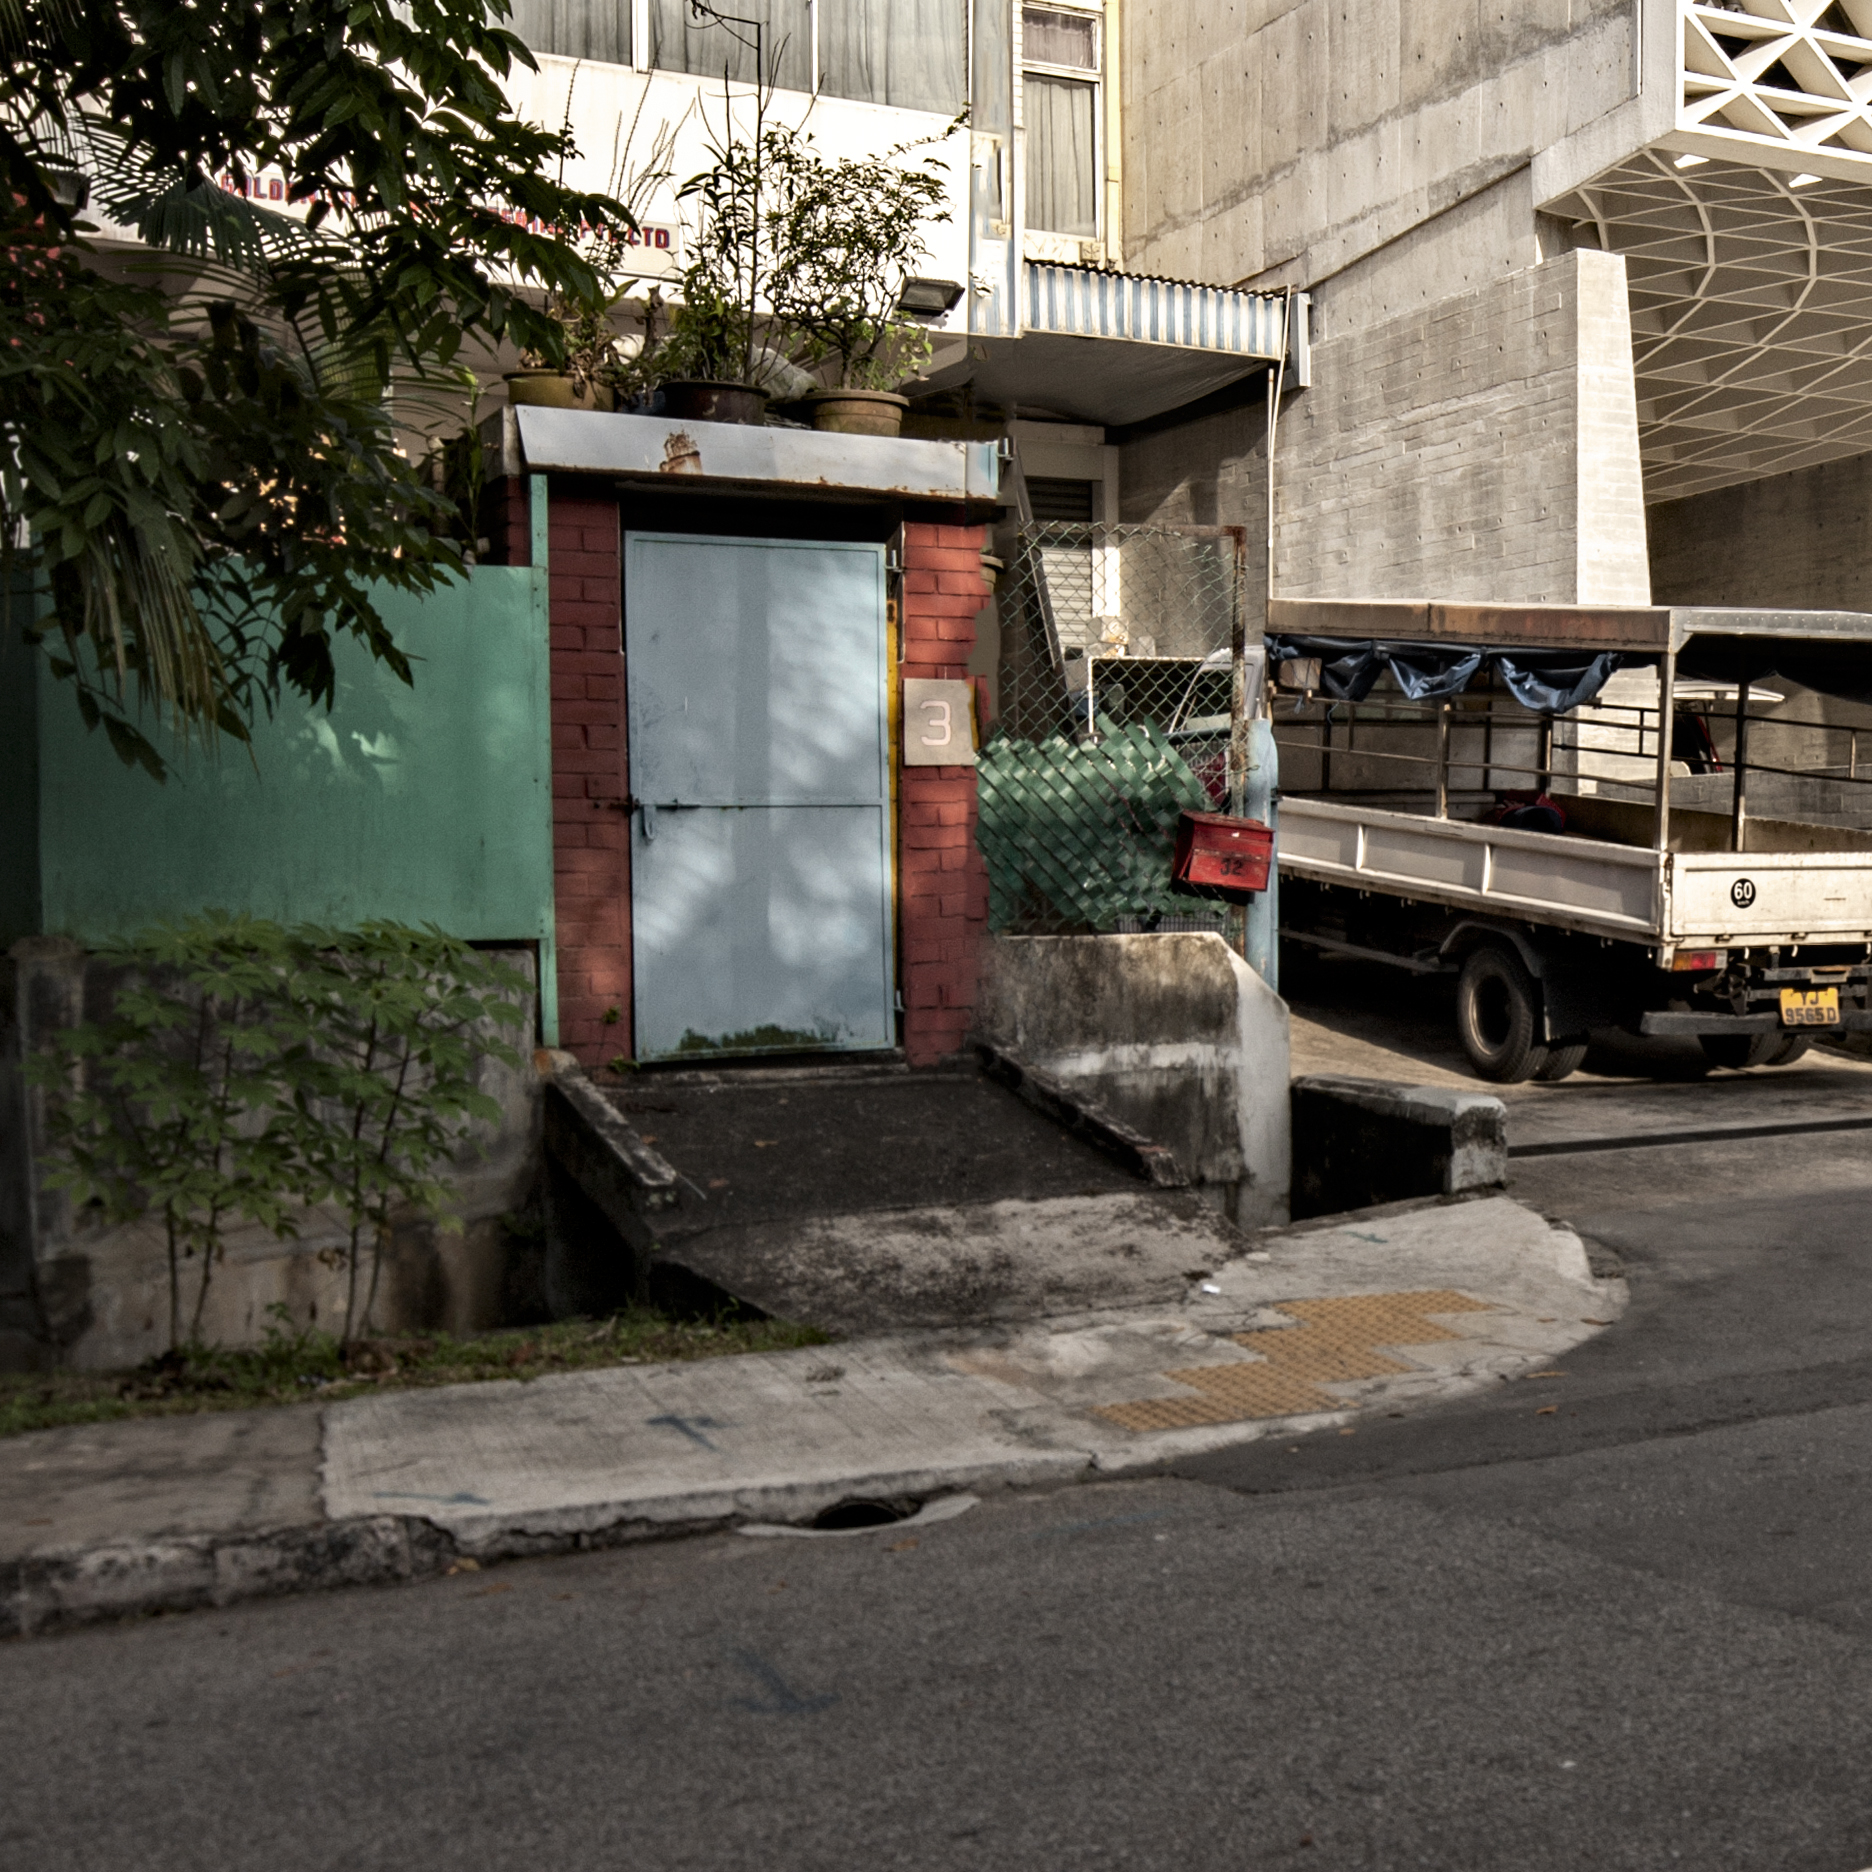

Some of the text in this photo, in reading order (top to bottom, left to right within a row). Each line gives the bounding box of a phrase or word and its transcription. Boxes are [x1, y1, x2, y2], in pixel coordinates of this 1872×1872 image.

[627, 225, 670, 249] LTD
[920, 700, 951, 746] 3
[1733, 881, 1753, 900] 60
